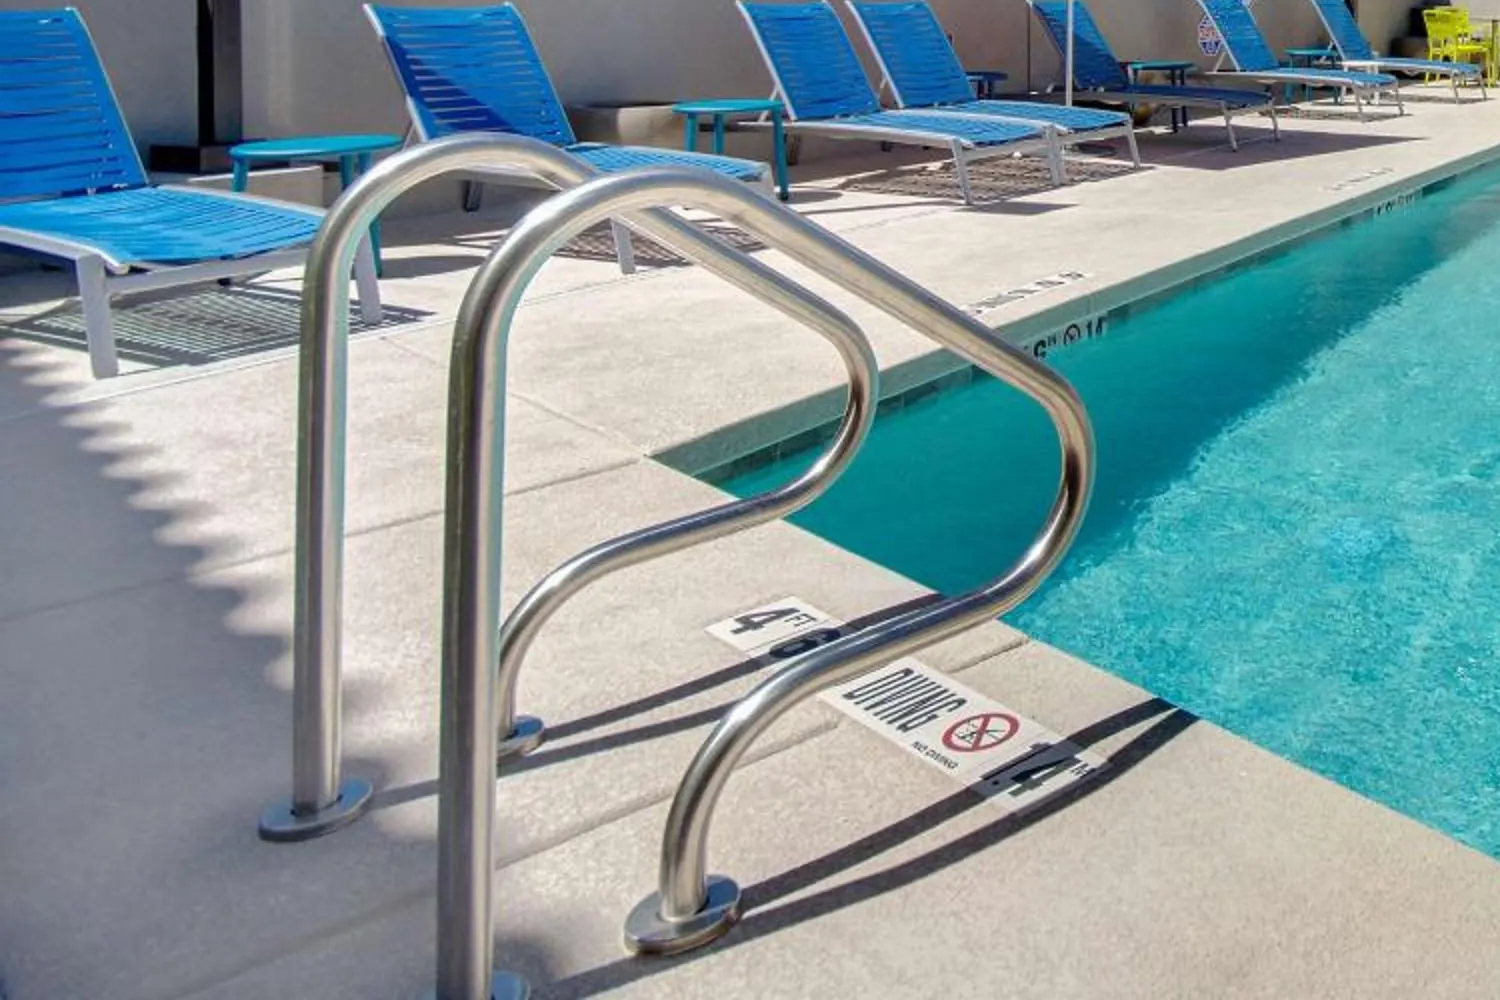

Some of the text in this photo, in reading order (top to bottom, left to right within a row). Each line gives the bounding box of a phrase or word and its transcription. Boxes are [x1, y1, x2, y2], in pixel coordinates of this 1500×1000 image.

[729, 607, 841, 658] 4 FT 6
[841, 667, 968, 733] DIVING
